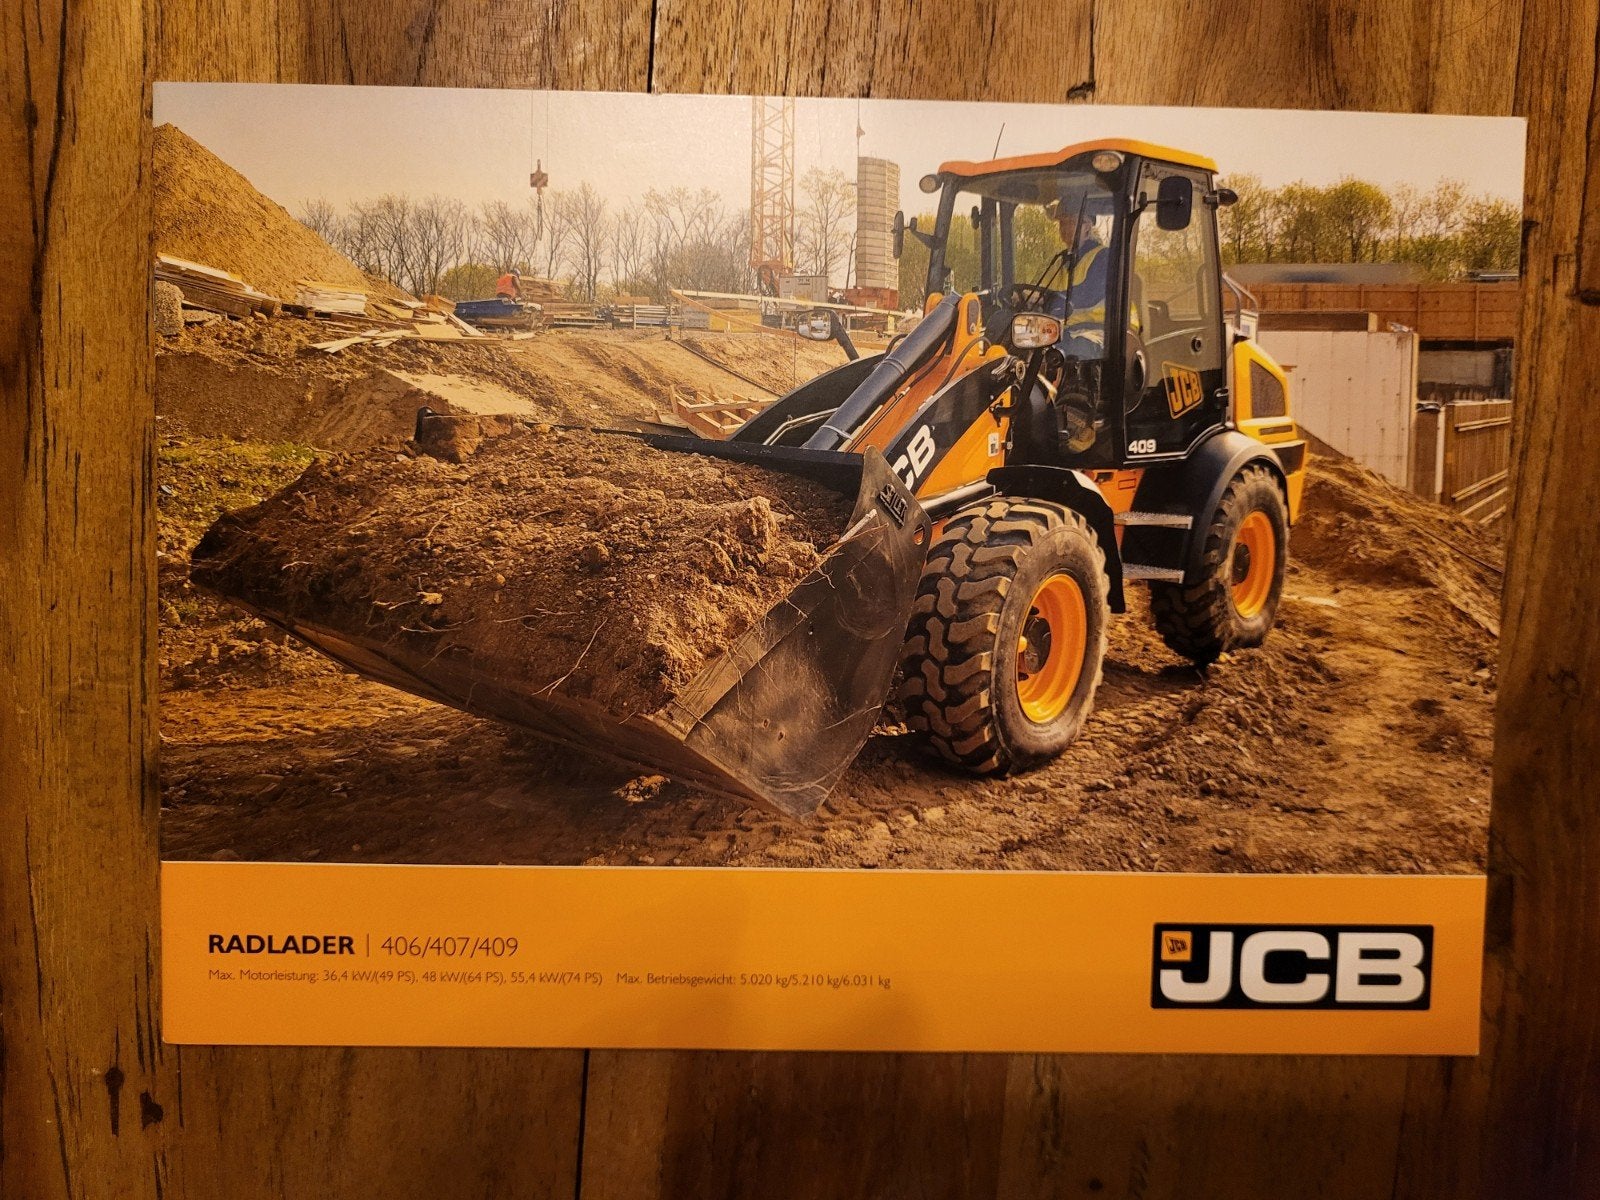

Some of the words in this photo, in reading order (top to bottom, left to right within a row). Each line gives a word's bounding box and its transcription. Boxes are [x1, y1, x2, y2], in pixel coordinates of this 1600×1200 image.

[1169, 367, 1201, 413] JCB
[1128, 439, 1157, 454] 409
[208, 934, 356, 955] RADLADER
[381, 936, 519, 958] 406/407/409
[208, 969, 236, 981] Max.
[240, 969, 319, 984] Motorleistung:
[323, 970, 349, 983] 36,4
[422, 971, 437, 982] 48
[511, 972, 536, 984] 55,4
[585, 972, 603, 985] PS)
[616, 972, 642, 984] Max.
[647, 972, 736, 987] Betriebsgewicht:
[740, 973, 773, 985] 5.020
[878, 975, 891, 989] kg
[1159, 931, 1425, 1003] JCB
